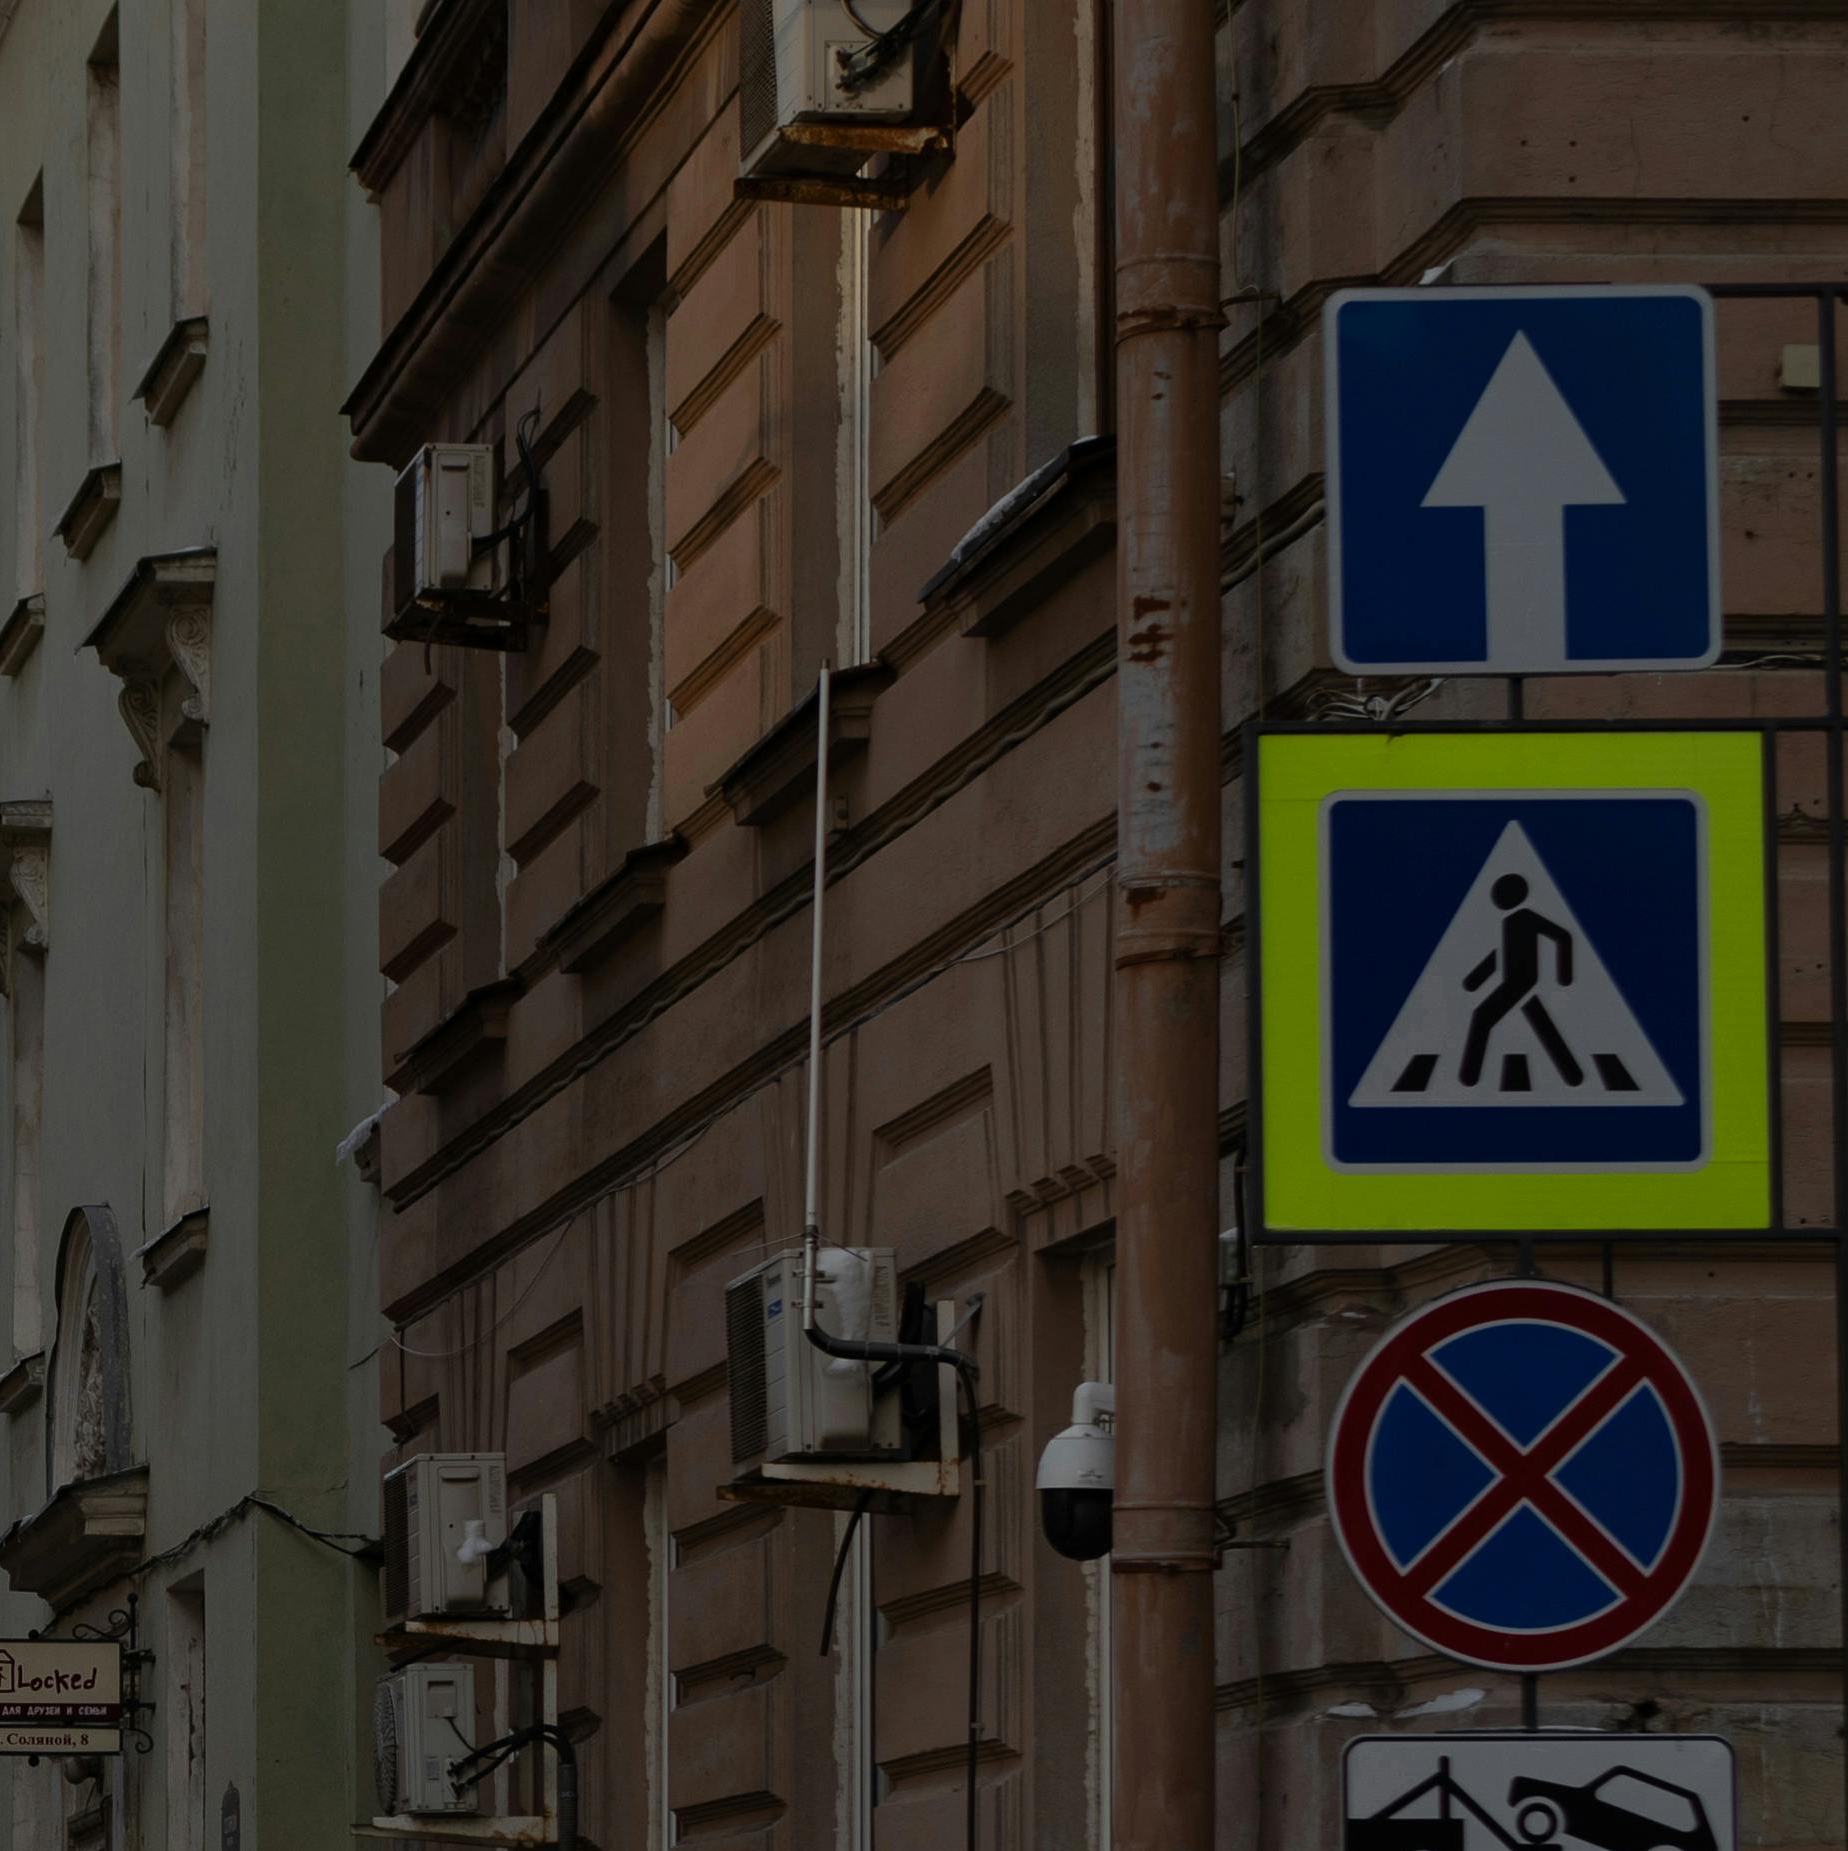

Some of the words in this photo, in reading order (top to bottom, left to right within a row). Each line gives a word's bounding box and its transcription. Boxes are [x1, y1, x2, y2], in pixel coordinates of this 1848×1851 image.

[17, 1665, 97, 1694] Locked
[1, 1704, 22, 1717] ДЛЯ
[65, 1705, 73, 1717] И
[6, 1733, 77, 1748] Соляной,
[80, 1734, 89, 1746] 8
